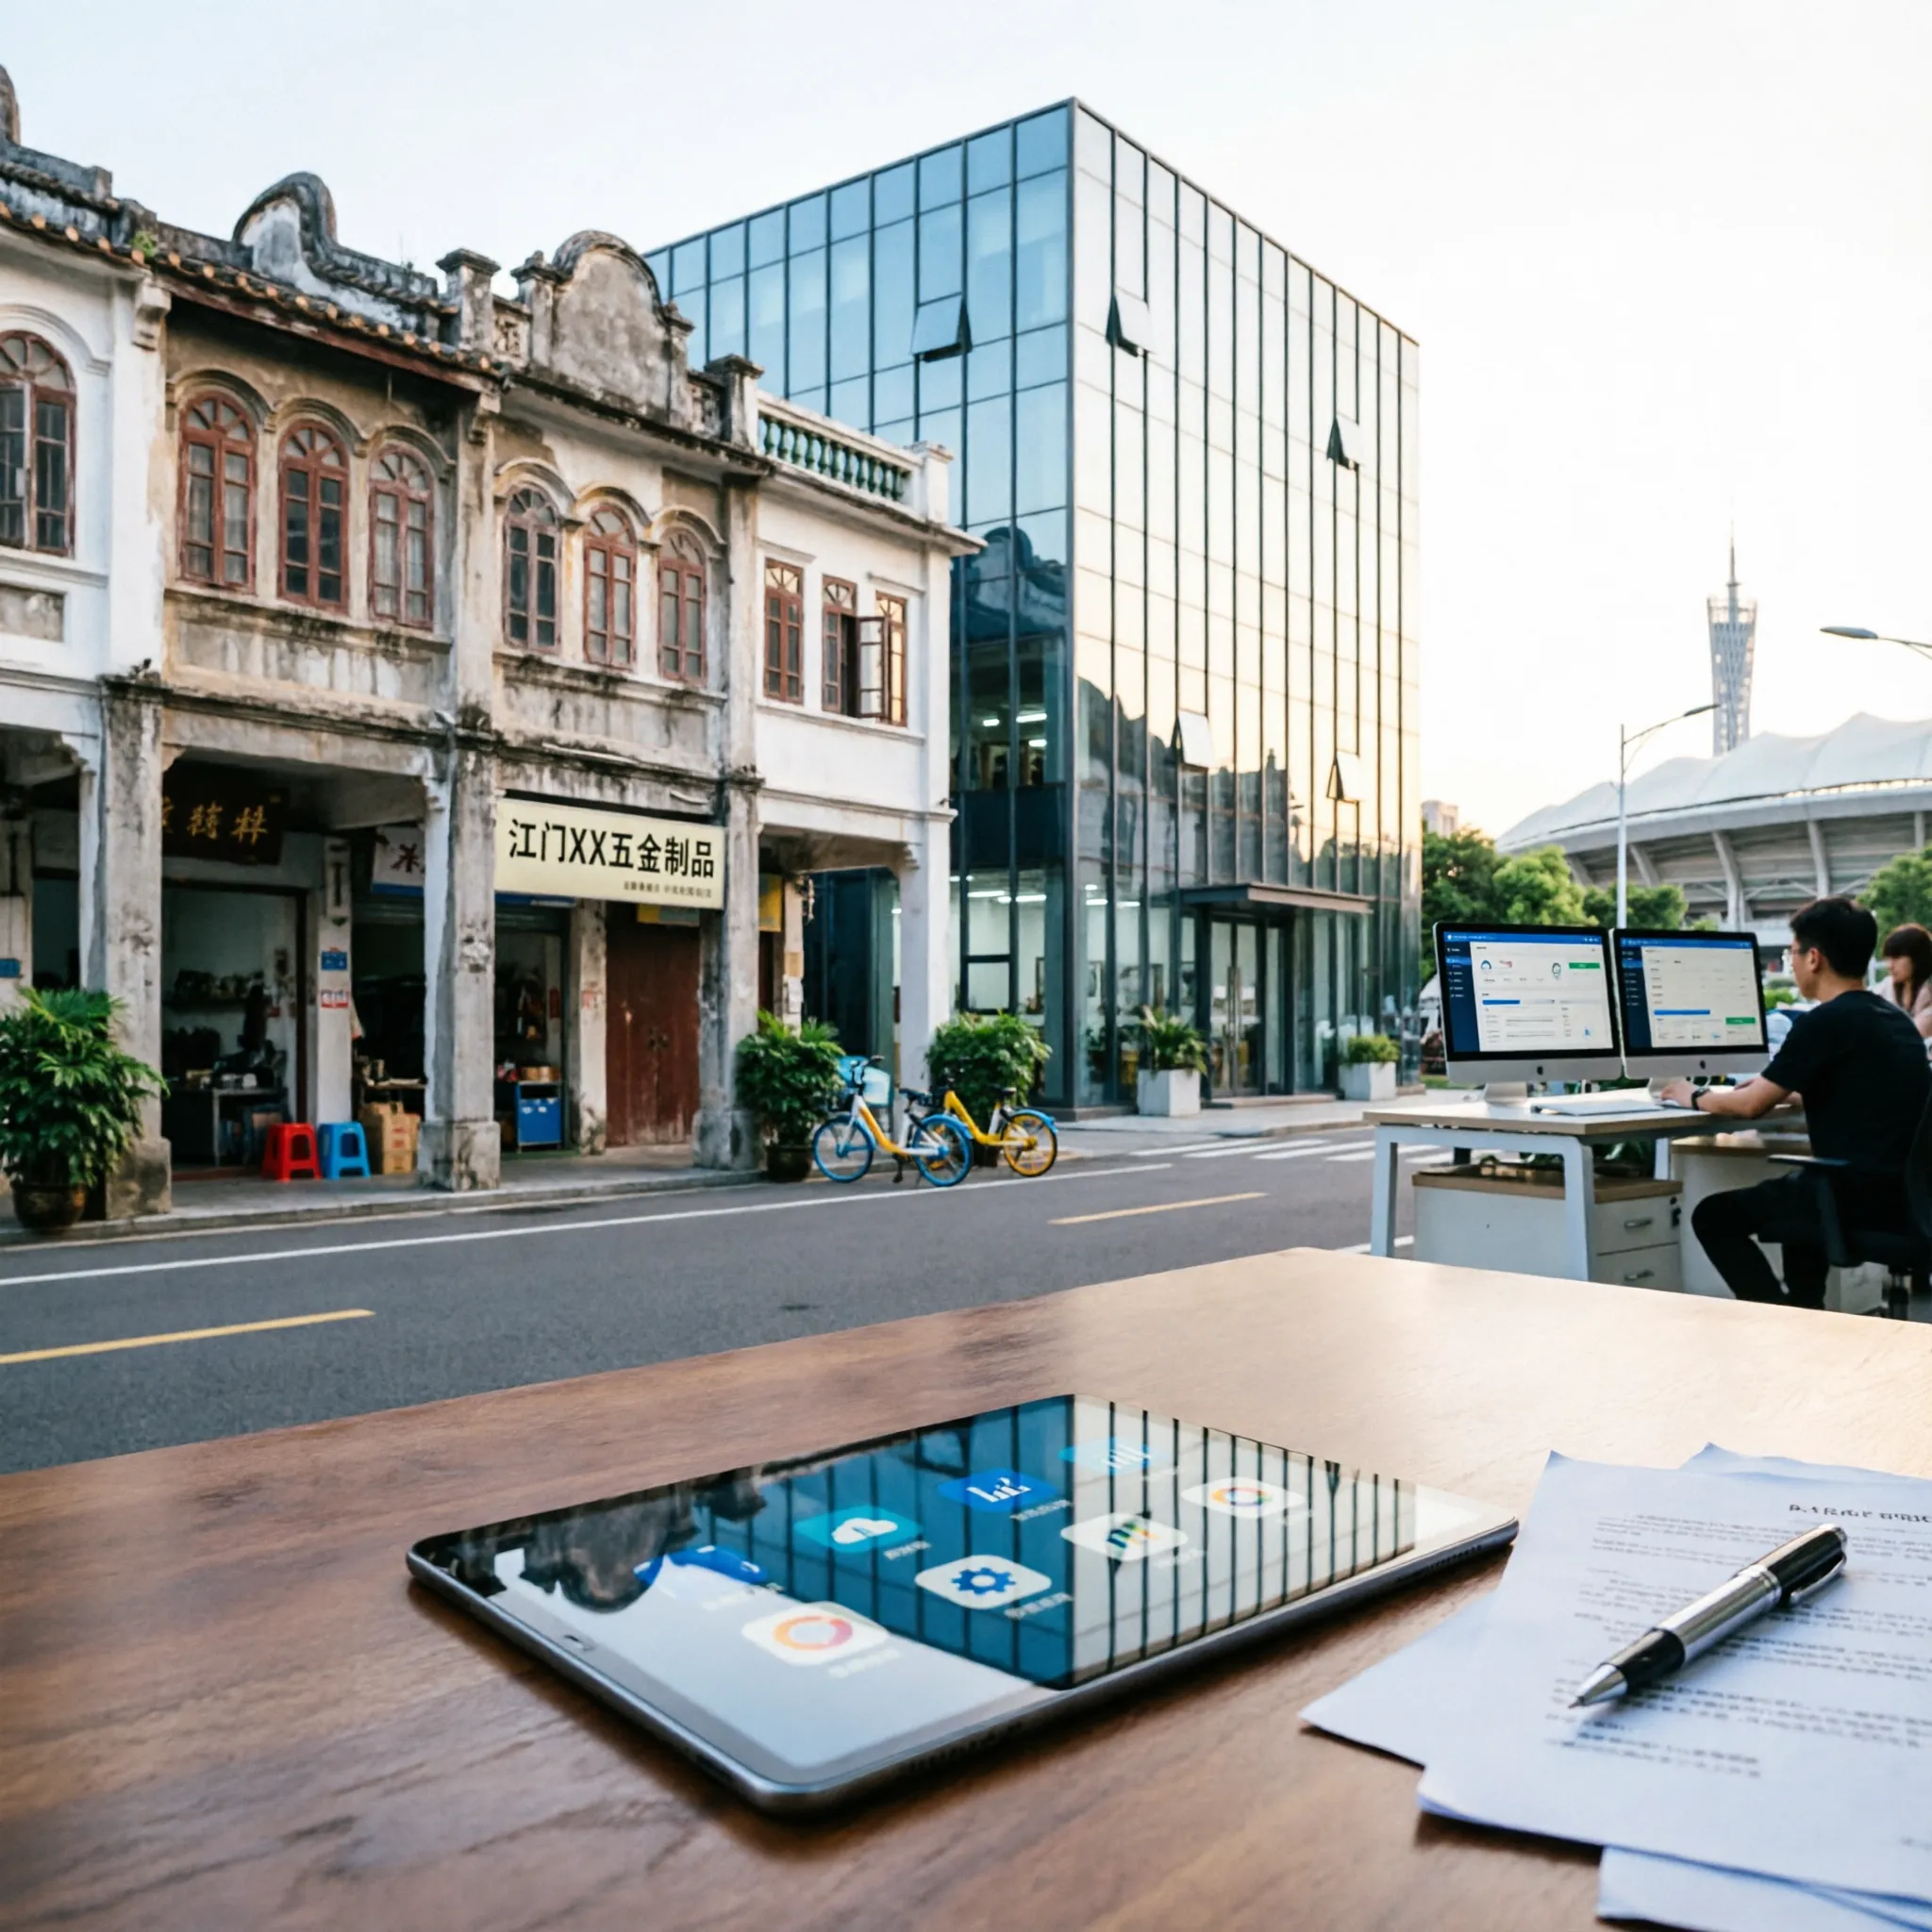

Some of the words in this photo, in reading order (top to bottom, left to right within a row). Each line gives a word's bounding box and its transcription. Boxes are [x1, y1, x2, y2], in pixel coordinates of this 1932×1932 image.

[508, 819, 714, 878] 江门XX五金制品
